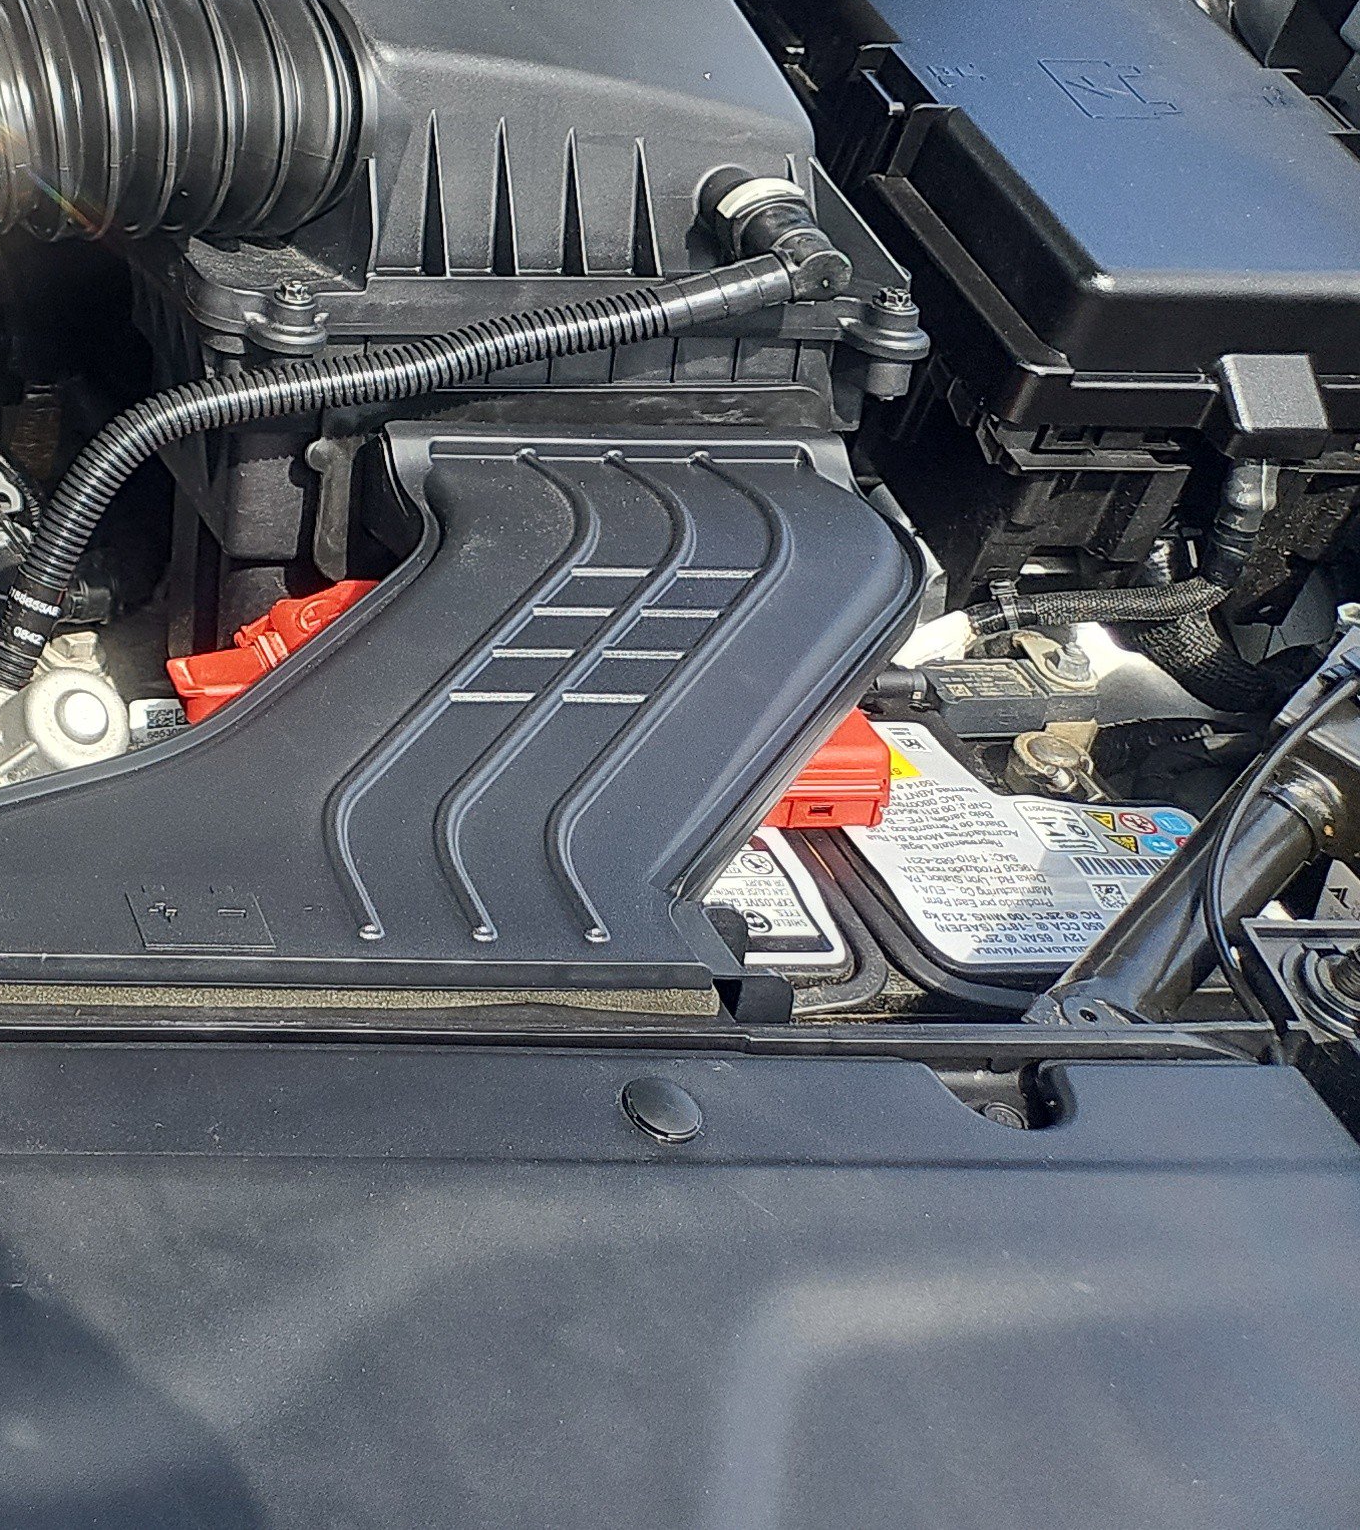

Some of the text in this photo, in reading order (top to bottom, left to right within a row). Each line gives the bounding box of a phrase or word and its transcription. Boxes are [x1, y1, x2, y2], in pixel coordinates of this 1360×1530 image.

[964, 874, 990, 886] Lyon
[743, 897, 796, 907] EXPLOSIVE
[953, 898, 979, 908] East
[979, 898, 997, 907] por
[998, 897, 1054, 908] Produzido
[923, 910, 940, 922] kg
[1008, 912, 1029, 921] 100
[1081, 910, 1102, 920] RC
[773, 918, 808, 928] SHIELD
[1035, 922, 1049, 931] @
[1049, 921, 1081, 931] CCA
[1081, 921, 1105, 931] 650
[1004, 933, 1017, 944] @
[1020, 932, 1053, 943] 65Ah
[1062, 932, 1088, 943] 12V
